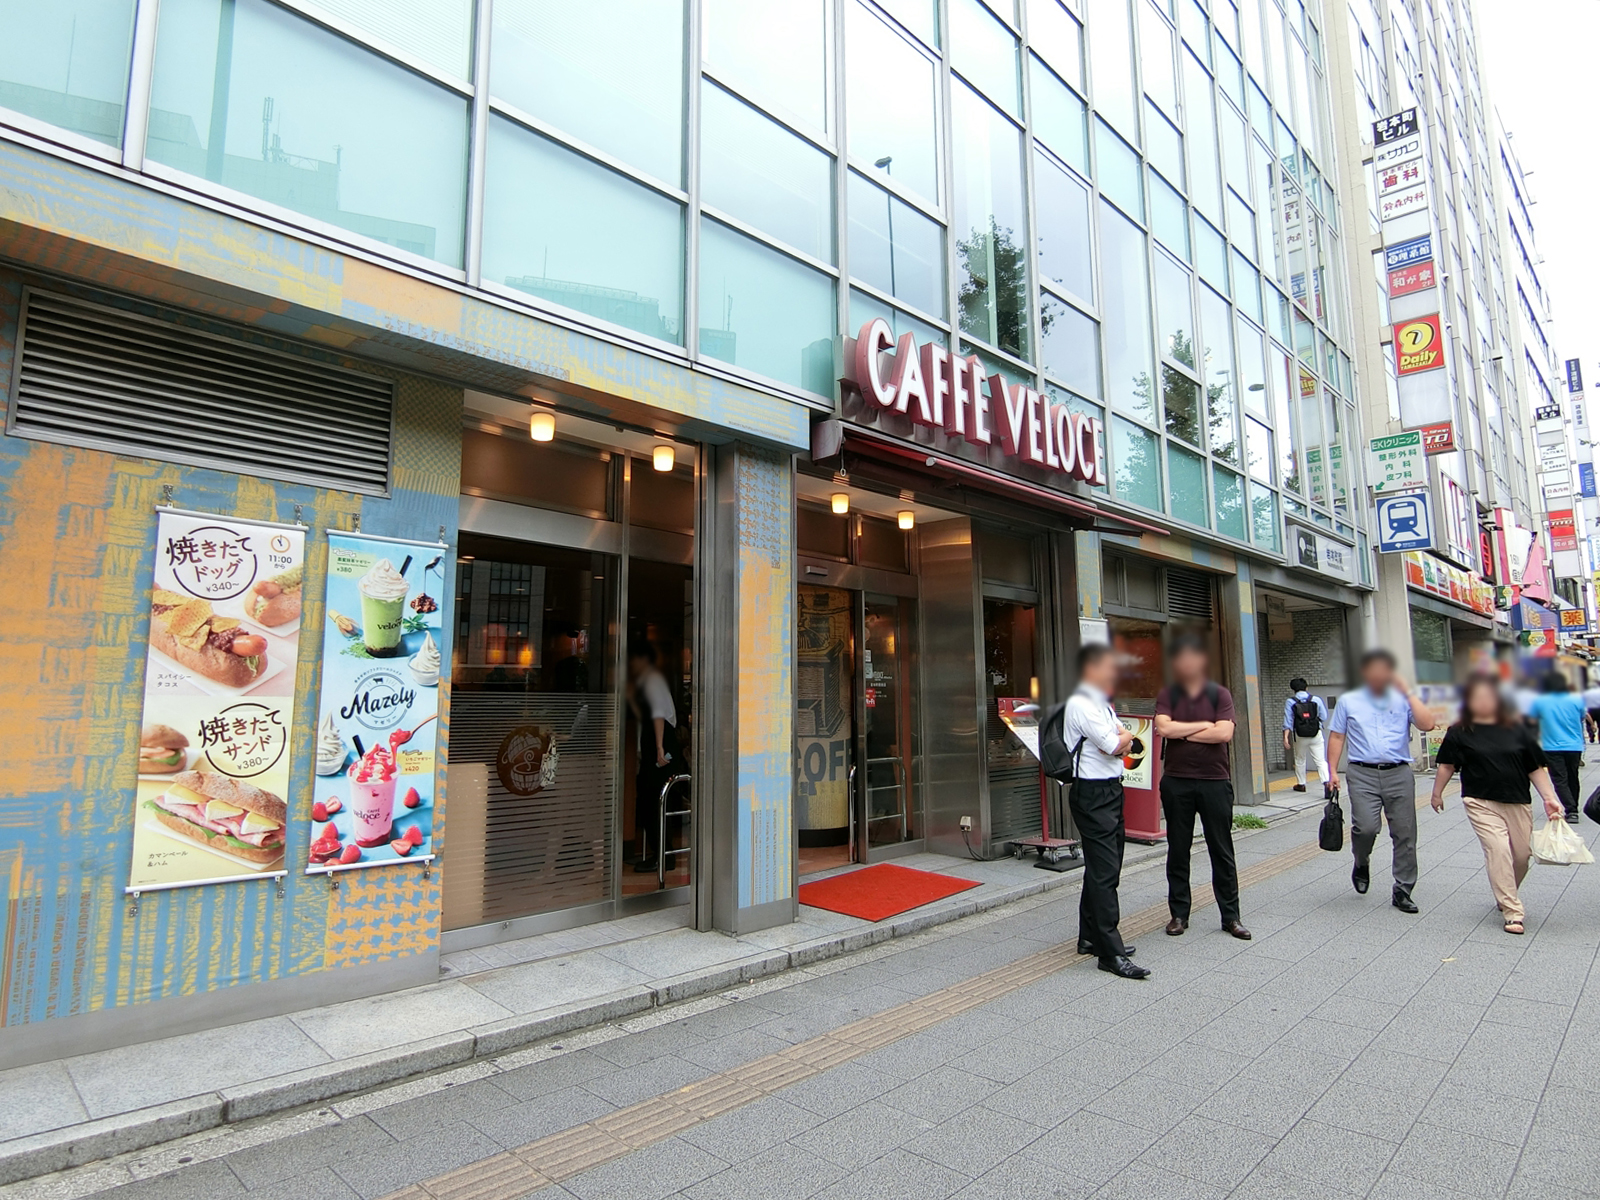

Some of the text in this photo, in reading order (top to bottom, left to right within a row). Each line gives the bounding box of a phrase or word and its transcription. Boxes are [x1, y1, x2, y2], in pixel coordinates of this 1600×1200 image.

[1377, 111, 1414, 132] 岩本町
[1382, 124, 1410, 141] ビル
[1383, 167, 1419, 188] 歯科
[1401, 351, 1439, 366] Daily
[990, 373, 1106, 486] VELOCE
[1372, 435, 1419, 450] EKIクリニック
[1379, 448, 1417, 461] 整形外科
[1386, 471, 1412, 481] 皮フ科
[166, 536, 253, 566] 焼きたて
[268, 555, 293, 564] 11:00
[194, 558, 244, 583] ドッグ
[1562, 611, 1582, 625] 薬
[340, 687, 417, 719] Mazely
[198, 710, 282, 748] 焼きたて
[223, 735, 272, 761] サンド
[1123, 774, 1143, 783] eloce
[149, 851, 188, 859] カマンベール
